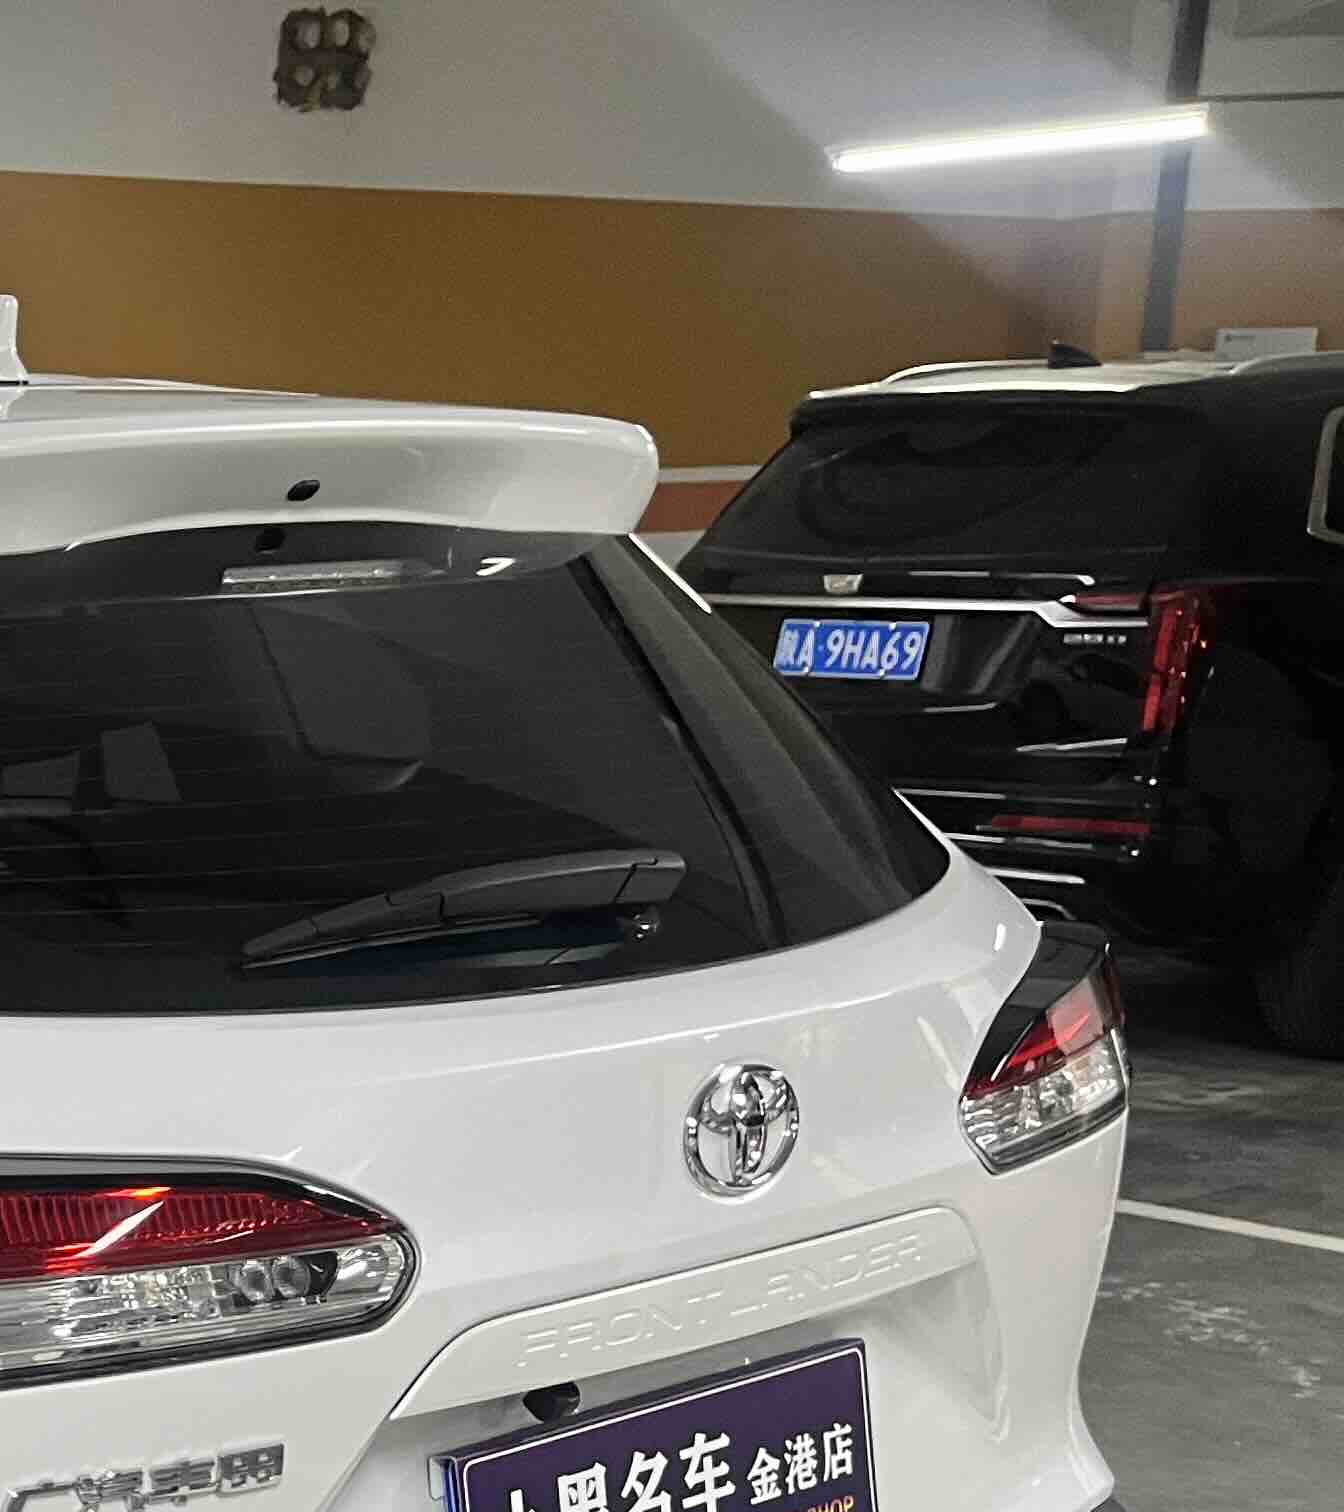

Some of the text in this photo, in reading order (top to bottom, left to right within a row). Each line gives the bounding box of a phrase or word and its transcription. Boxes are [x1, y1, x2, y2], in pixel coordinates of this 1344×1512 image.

[515, 1234, 921, 1368] FRONTLANDER
[746, 1422, 854, 1506] 金港店
